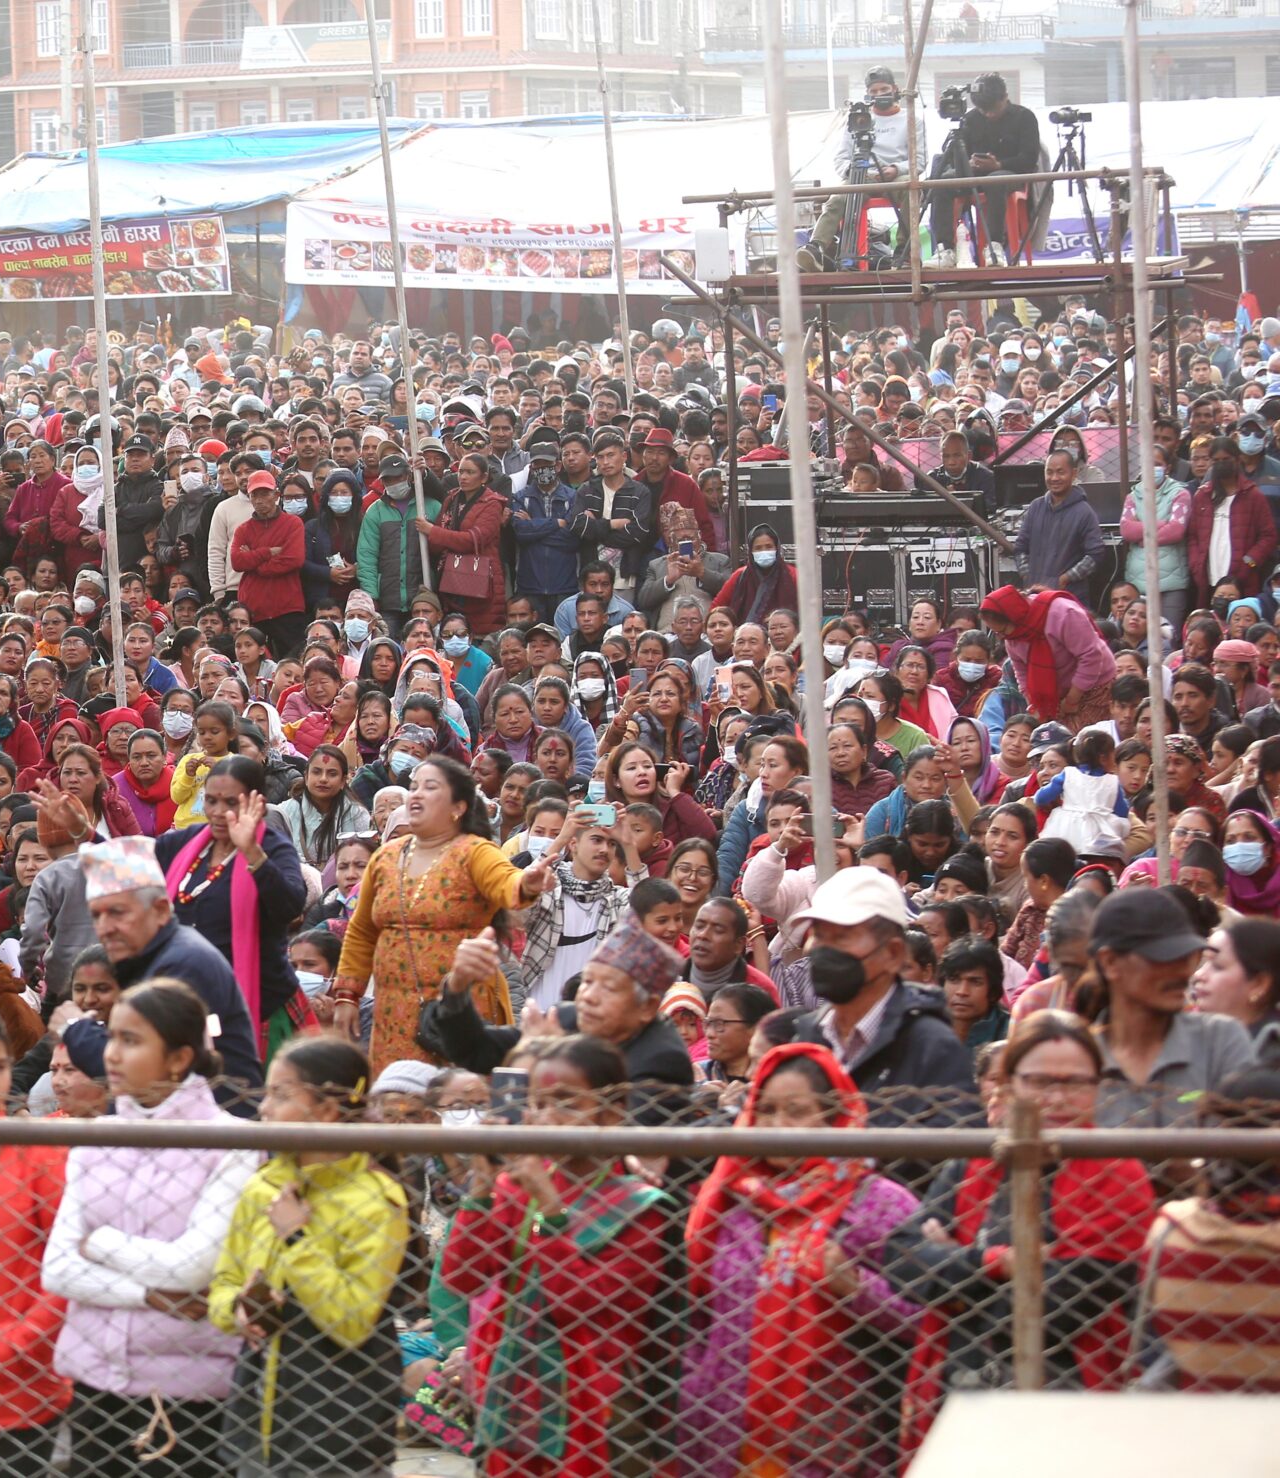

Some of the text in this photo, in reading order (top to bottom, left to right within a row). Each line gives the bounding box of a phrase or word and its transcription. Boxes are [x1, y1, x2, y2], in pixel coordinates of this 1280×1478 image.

[319, 25, 388, 37] GREEN TRA
[638, 217, 695, 234] घर
[35, 234, 61, 250] दम
[122, 226, 161, 243] हाउस
[912, 556, 963, 573] SK Sound
